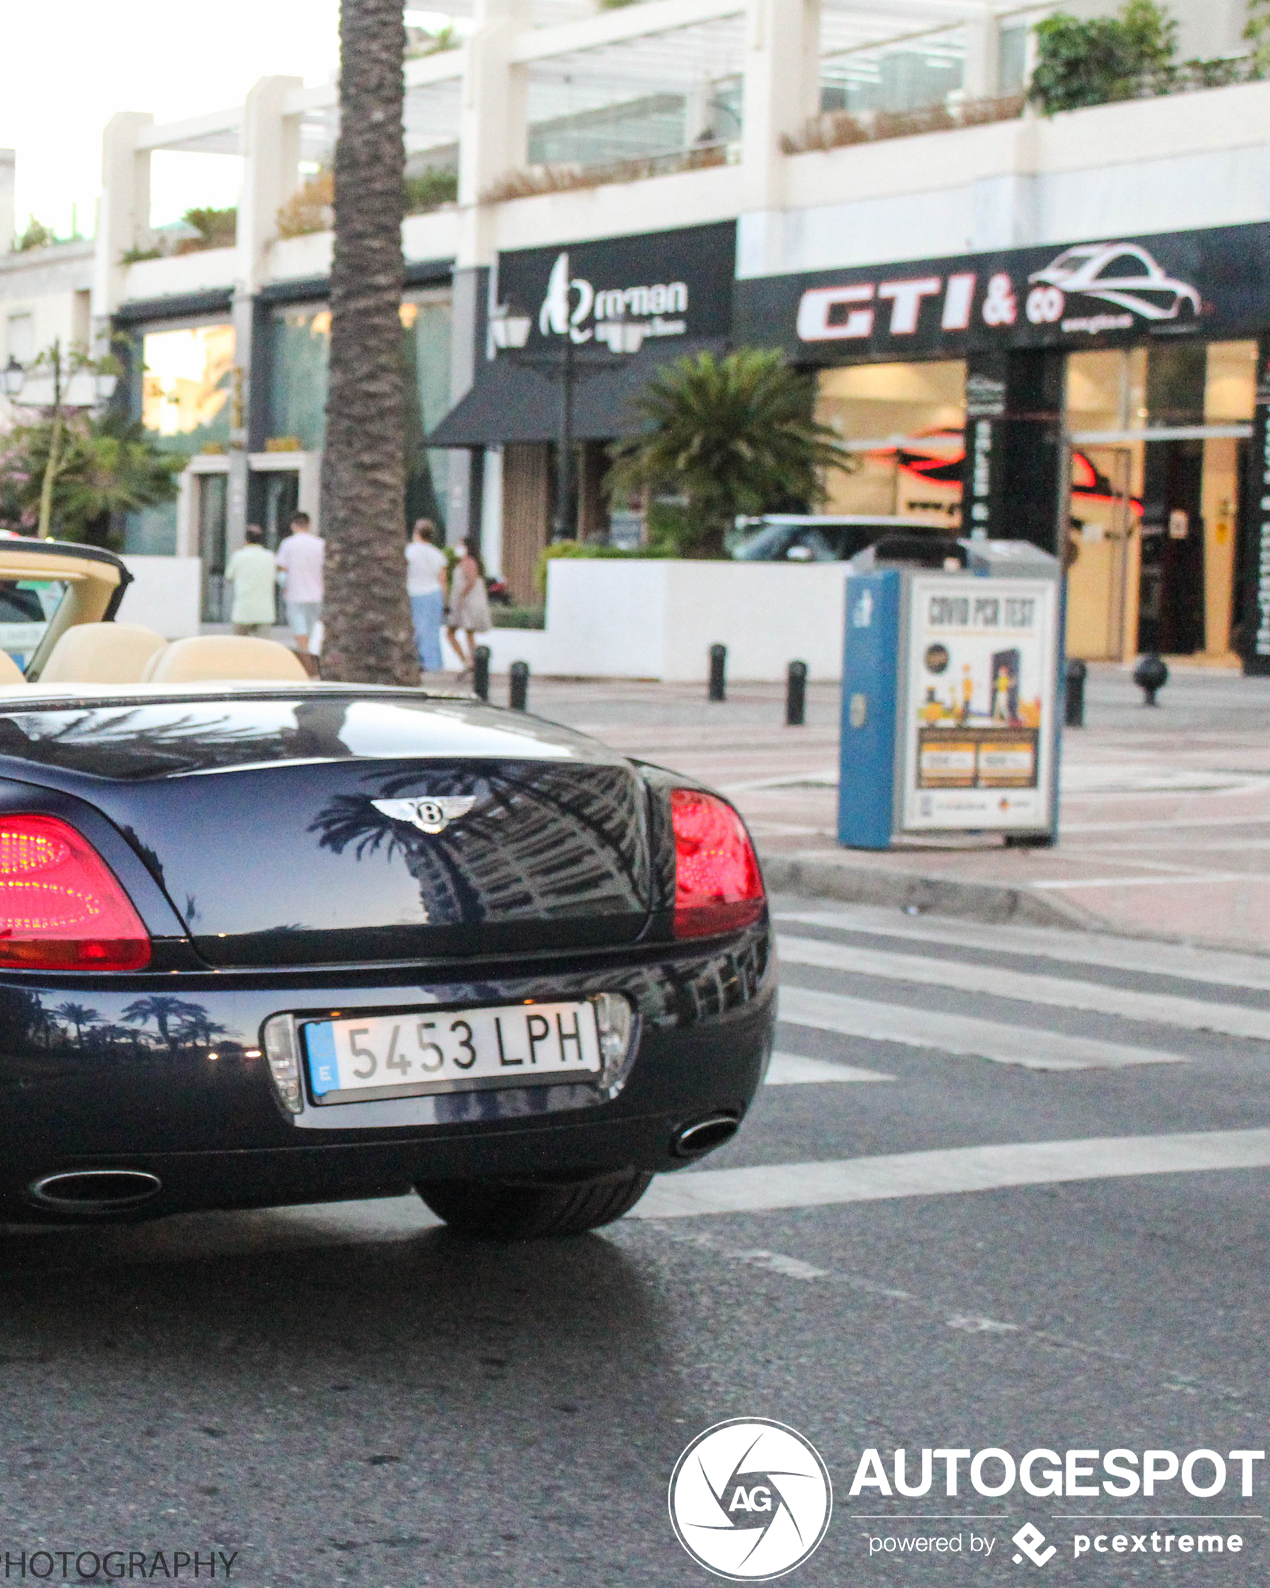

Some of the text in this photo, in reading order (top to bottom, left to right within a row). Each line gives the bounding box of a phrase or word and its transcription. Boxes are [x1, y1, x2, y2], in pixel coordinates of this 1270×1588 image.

[796, 272, 976, 342] GTI
[982, 272, 1017, 326] &
[930, 598, 1034, 628] COVID PCR TEST
[348, 1012, 583, 1079] 5453 LPH
[319, 1066, 332, 1081] E
